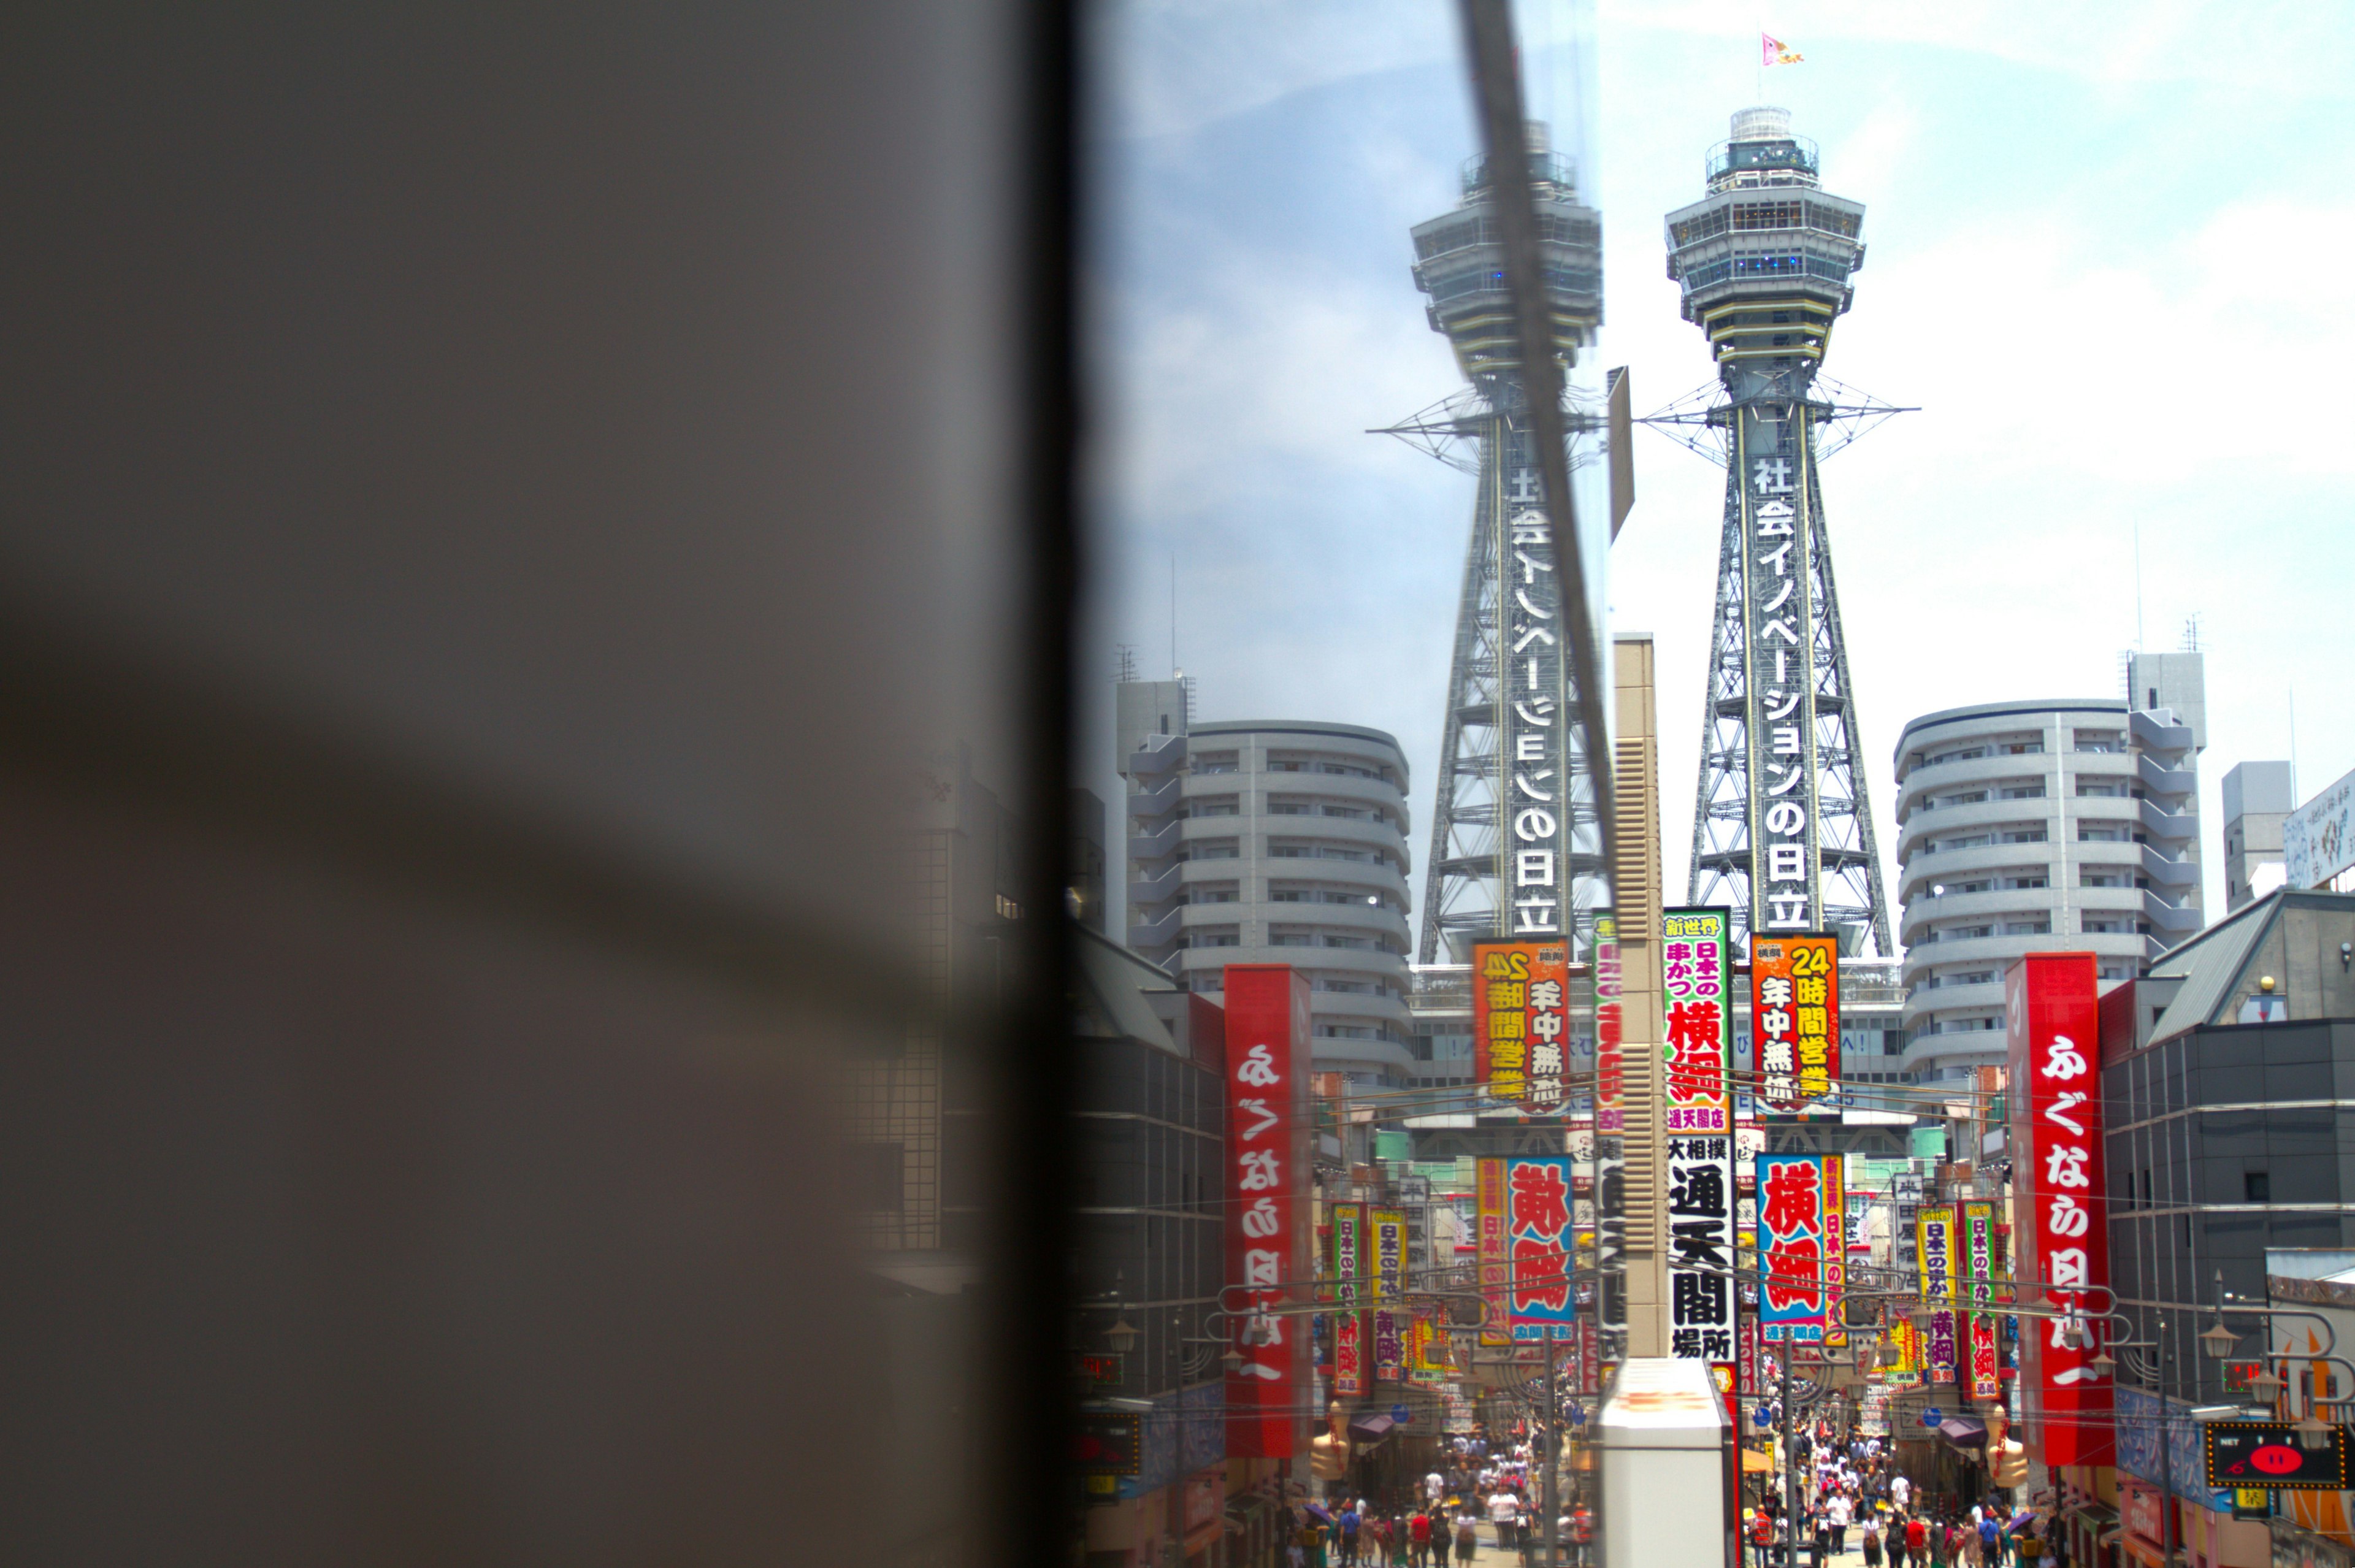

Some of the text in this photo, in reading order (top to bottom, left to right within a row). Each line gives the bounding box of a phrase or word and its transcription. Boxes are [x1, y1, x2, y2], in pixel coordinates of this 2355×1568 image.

[1754, 457, 1810, 928] 社会イノベーションの日立
[1664, 917, 1720, 937] 新世界
[1666, 943, 1692, 996] 串かつ
[1695, 942, 1720, 995] 日本一の
[1760, 976, 1794, 1103] 年中無休
[1791, 946, 1832, 1097] 24時間営業
[1666, 1000, 1722, 1102] 横綱
[1668, 1108, 1724, 1129] 通天閣店
[1668, 1138, 1727, 1161] 大相撲
[1826, 1158, 1839, 1209] 新世界
[1670, 1164, 1728, 1326] 通天閣
[1763, 1163, 1820, 1310] 横綱
[1671, 1328, 1731, 1360] 場所
[1977, 1382, 1995, 1396] 酒処
[2220, 1438, 2239, 1447] NET
